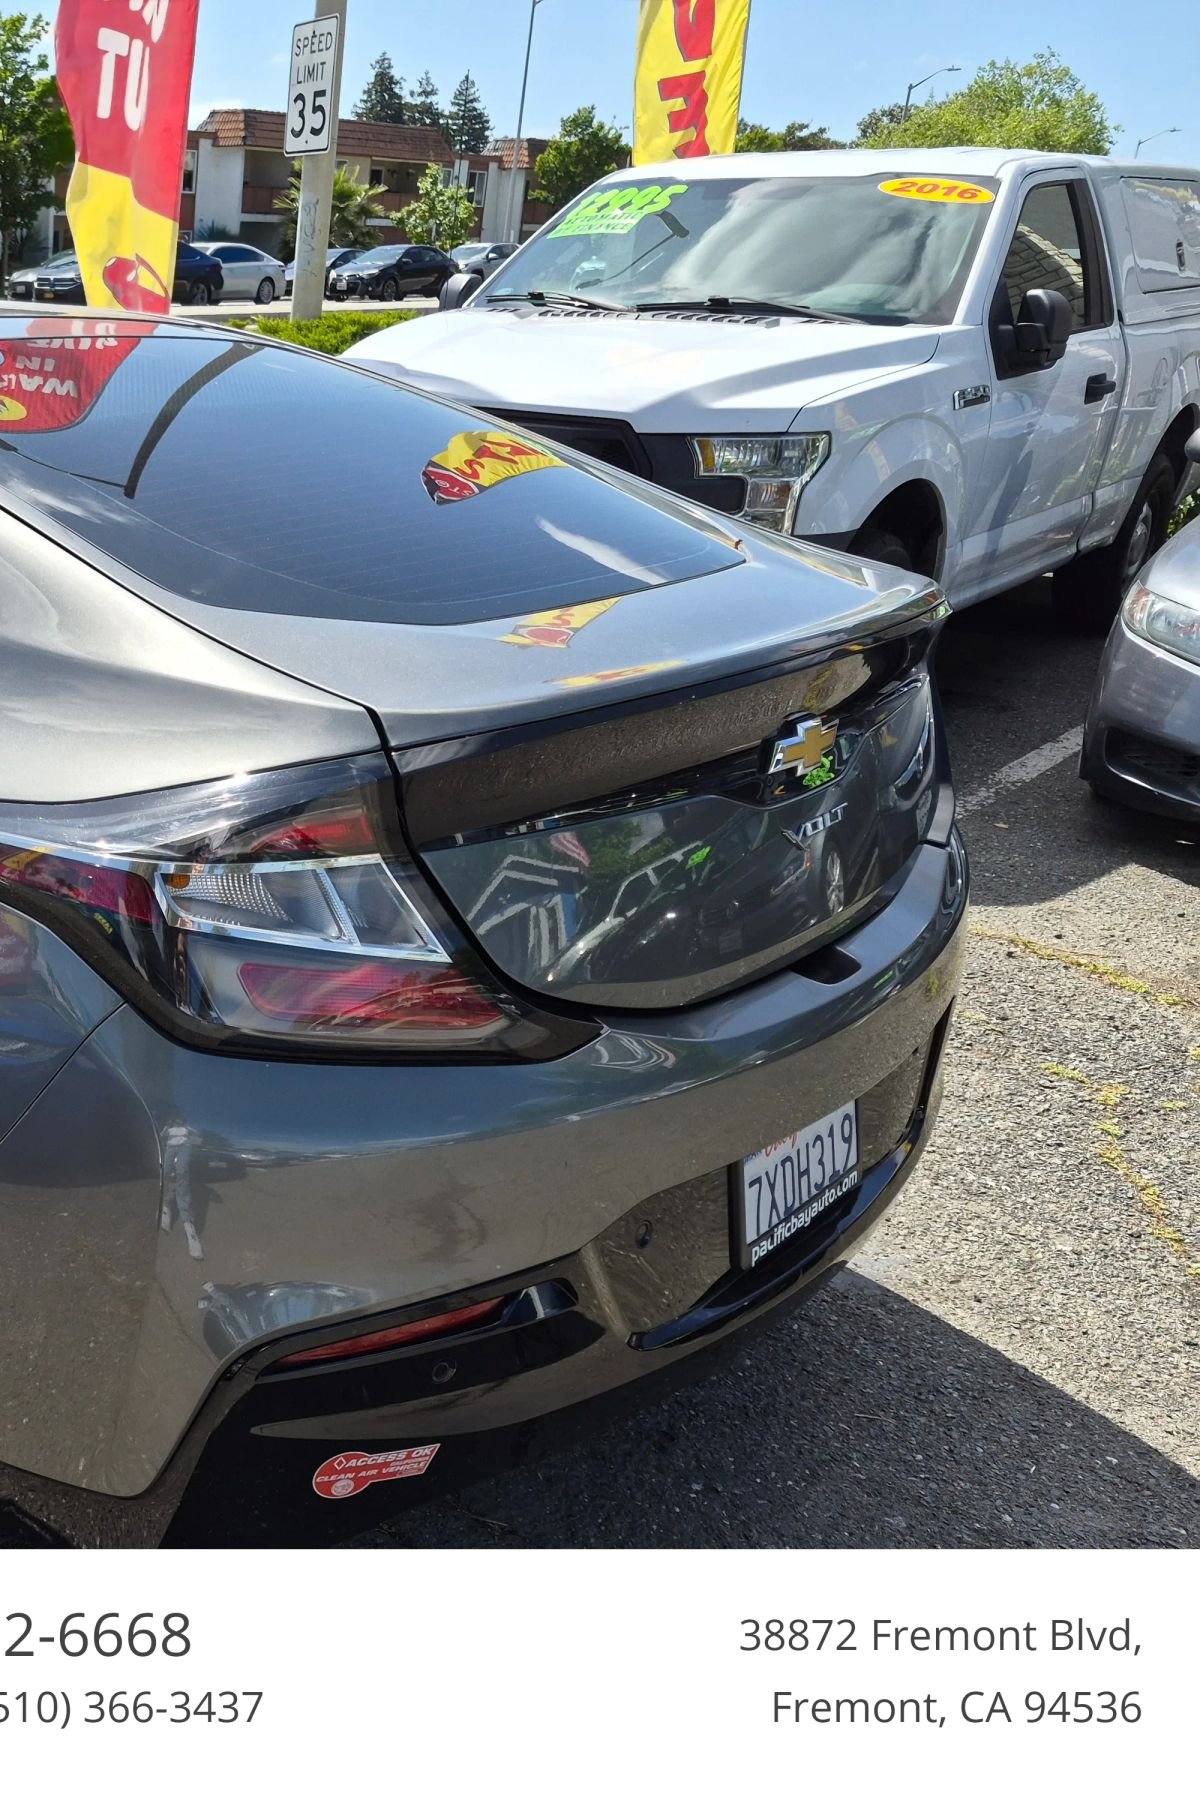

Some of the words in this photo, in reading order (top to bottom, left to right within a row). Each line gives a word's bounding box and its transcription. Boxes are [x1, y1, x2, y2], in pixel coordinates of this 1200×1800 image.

[295, 32, 333, 57] SPEED
[296, 62, 327, 84] LIMIT
[290, 89, 327, 138] 35
[890, 181, 982, 199] 2016
[780, 802, 848, 851] VOLT
[748, 1112, 854, 1237] 7XDH319
[751, 1170, 858, 1267] pacificbayauto.com
[345, 1452, 408, 1468] ACCESS
[411, 1447, 434, 1458] OK
[316, 1472, 355, 1483] CLEAN
[358, 1469, 378, 1478] AIR
[382, 1461, 427, 1474] VEHICLE
